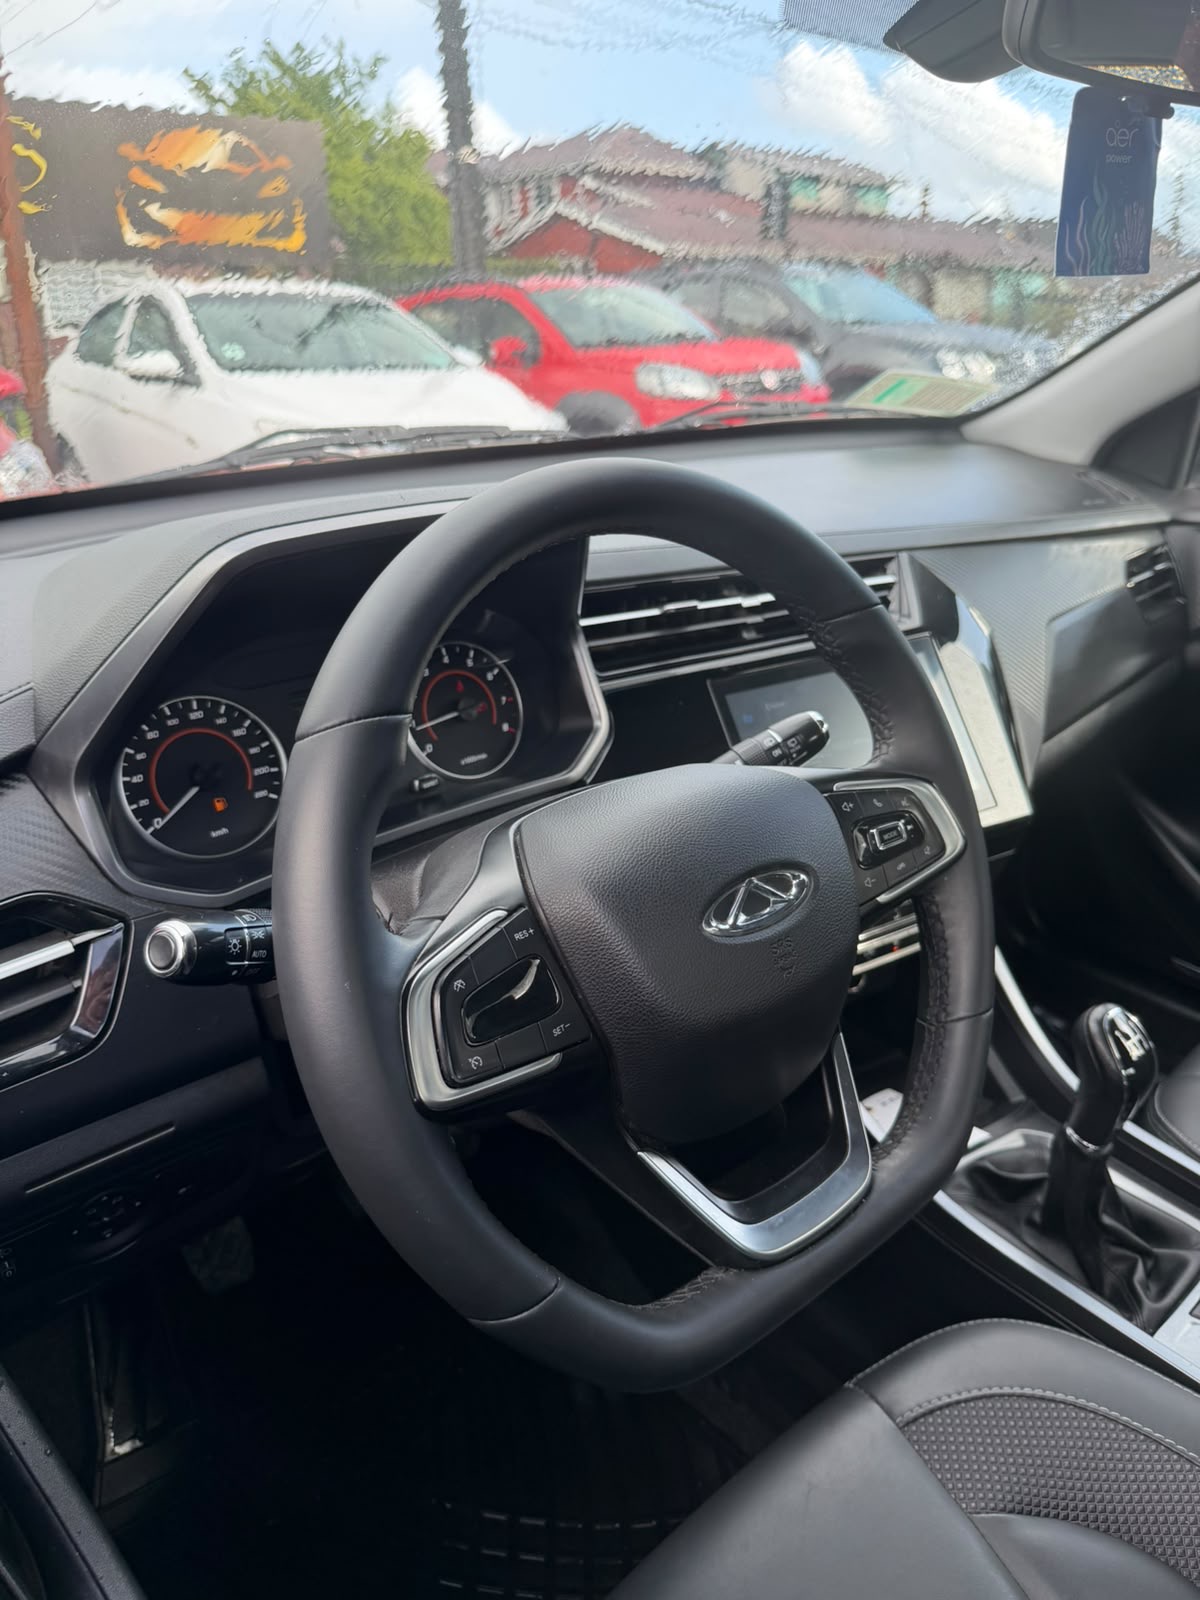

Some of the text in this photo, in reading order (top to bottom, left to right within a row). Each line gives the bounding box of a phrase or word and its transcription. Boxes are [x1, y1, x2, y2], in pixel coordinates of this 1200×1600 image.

[189, 711, 204, 720] 120
[166, 718, 179, 726] 100
[426, 743, 434, 753] 0
[254, 766, 270, 776] 200
[131, 774, 144, 783] 40
[138, 799, 150, 807] 20
[153, 817, 163, 829] 0
[513, 927, 536, 941] RES+
[251, 950, 267, 958] AUTO
